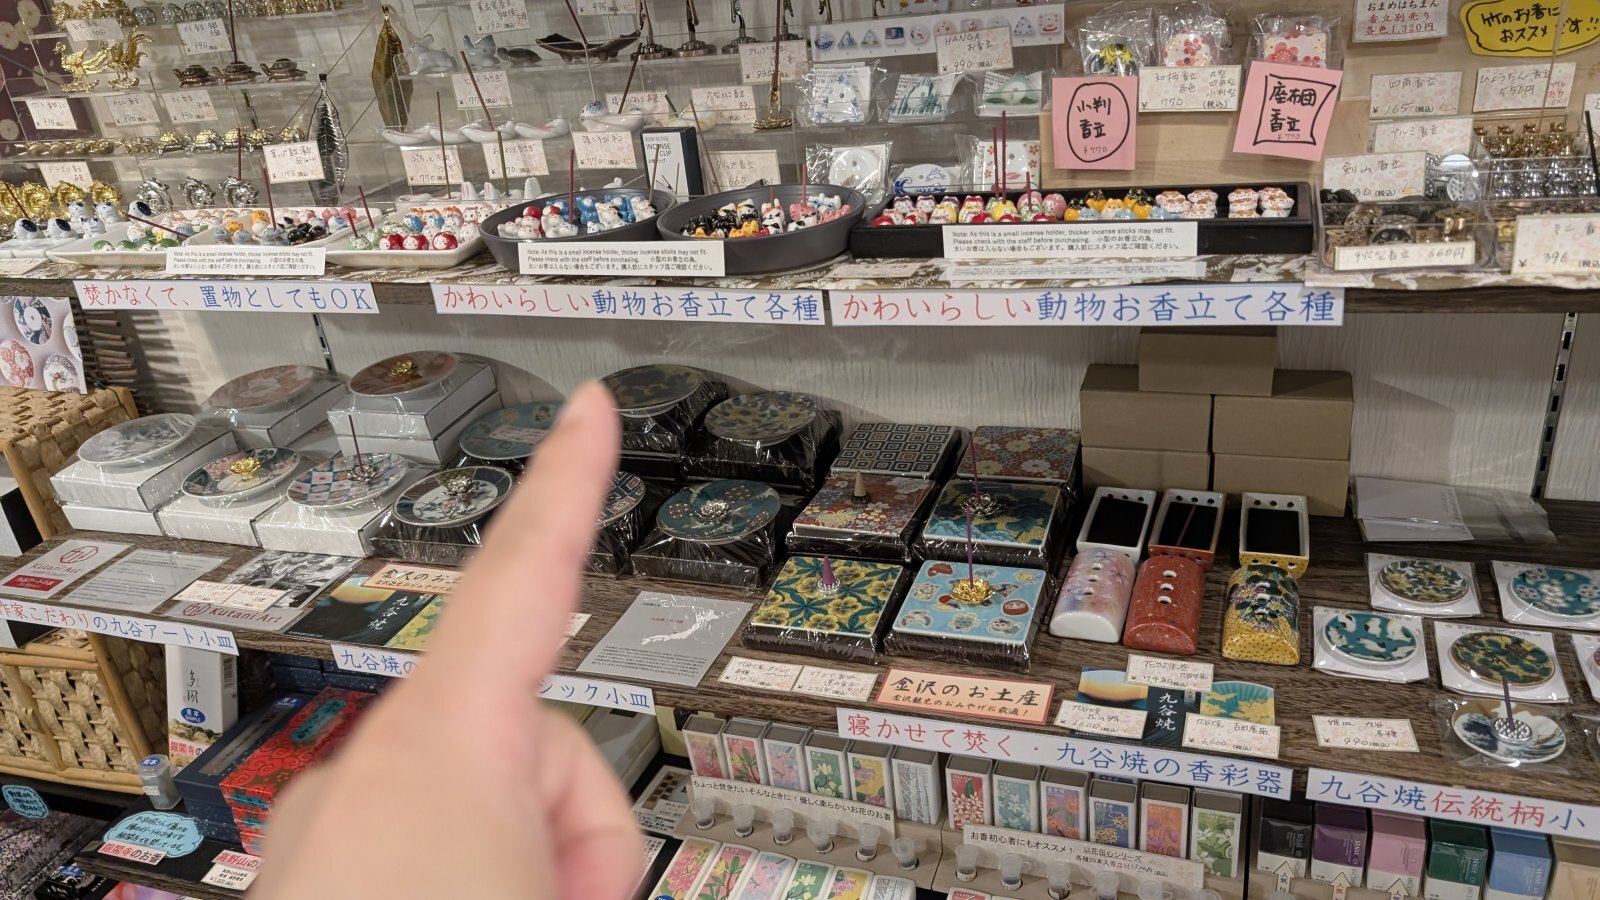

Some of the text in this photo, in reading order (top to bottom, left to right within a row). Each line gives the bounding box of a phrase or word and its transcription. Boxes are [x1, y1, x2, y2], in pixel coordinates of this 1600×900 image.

[1367, 0, 1439, 12] おまめはちまん
[1368, 12, 1430, 23] 香立別売り
[1481, 4, 1561, 27] 竹のお香に
[945, 33, 980, 46] HANGA
[954, 61, 973, 72] 990
[1479, 71, 1528, 84] ひょうたん
[1269, 82, 1317, 106] 座布団
[1498, 84, 1535, 97] 550円
[1078, 96, 1111, 116] 小判
[1161, 98, 1183, 108] 770
[1202, 100, 1228, 109] (税込)
[1384, 103, 1414, 114] 165
[1270, 108, 1300, 132] 香立
[1080, 120, 1106, 140] 香立
[586, 157, 602, 166] 770
[728, 178, 746, 186] 660
[1518, 251, 1568, 268] ¥ 396
[443, 286, 820, 322] かわいらしい動物お香立て各種
[844, 290, 1336, 322] かわいらしい動物お香立て各種
[208, 608, 282, 623] Kutani Art
[892, 676, 1041, 707] 金沢のお土産
[1155, 692, 1178, 732] 九谷焼
[1202, 737, 1227, 748] 6,600
[1344, 738, 1368, 746] 990
[847, 713, 1284, 795] 寝かせて焚く・九谷焼の香彩器
[1320, 773, 1587, 832] 九谷焼伝統柄小
[104, 843, 162, 864] 銀閣寺のお香
